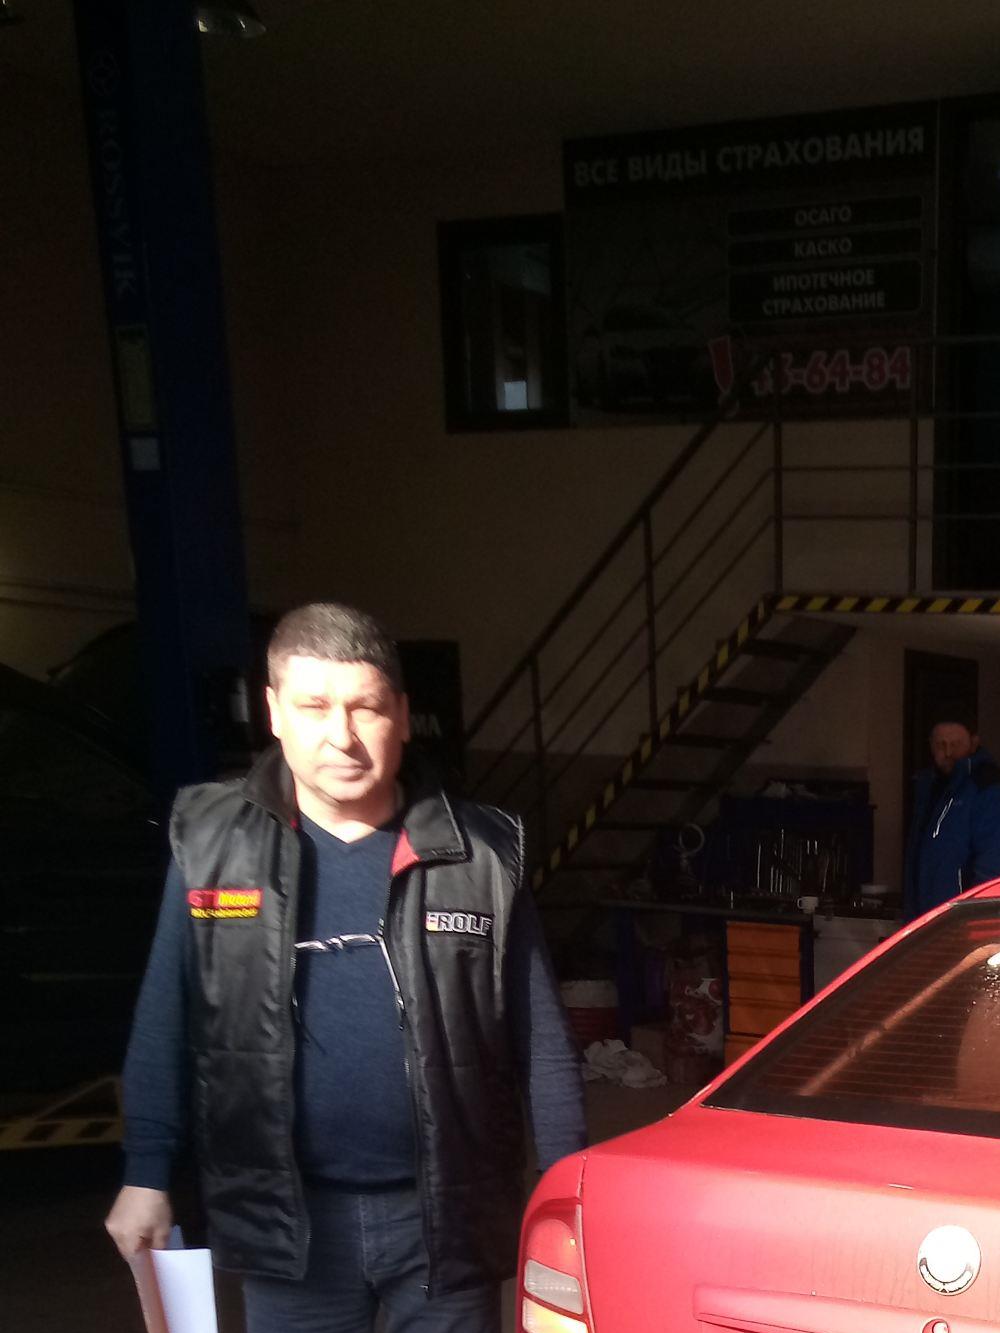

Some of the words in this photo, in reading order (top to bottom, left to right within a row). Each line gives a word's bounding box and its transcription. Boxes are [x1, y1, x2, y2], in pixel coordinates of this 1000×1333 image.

[573, 160, 618, 188] ВСЕ
[627, 151, 707, 183] ВИДЫ
[716, 125, 925, 174] СТРАХОВАНИЯ
[794, 206, 853, 227] ОСАГО
[794, 238, 853, 260] КАСКО
[772, 269, 876, 294] ИПОТЕЧНОЕ
[762, 291, 887, 317] СТРАХОВАНИЕ
